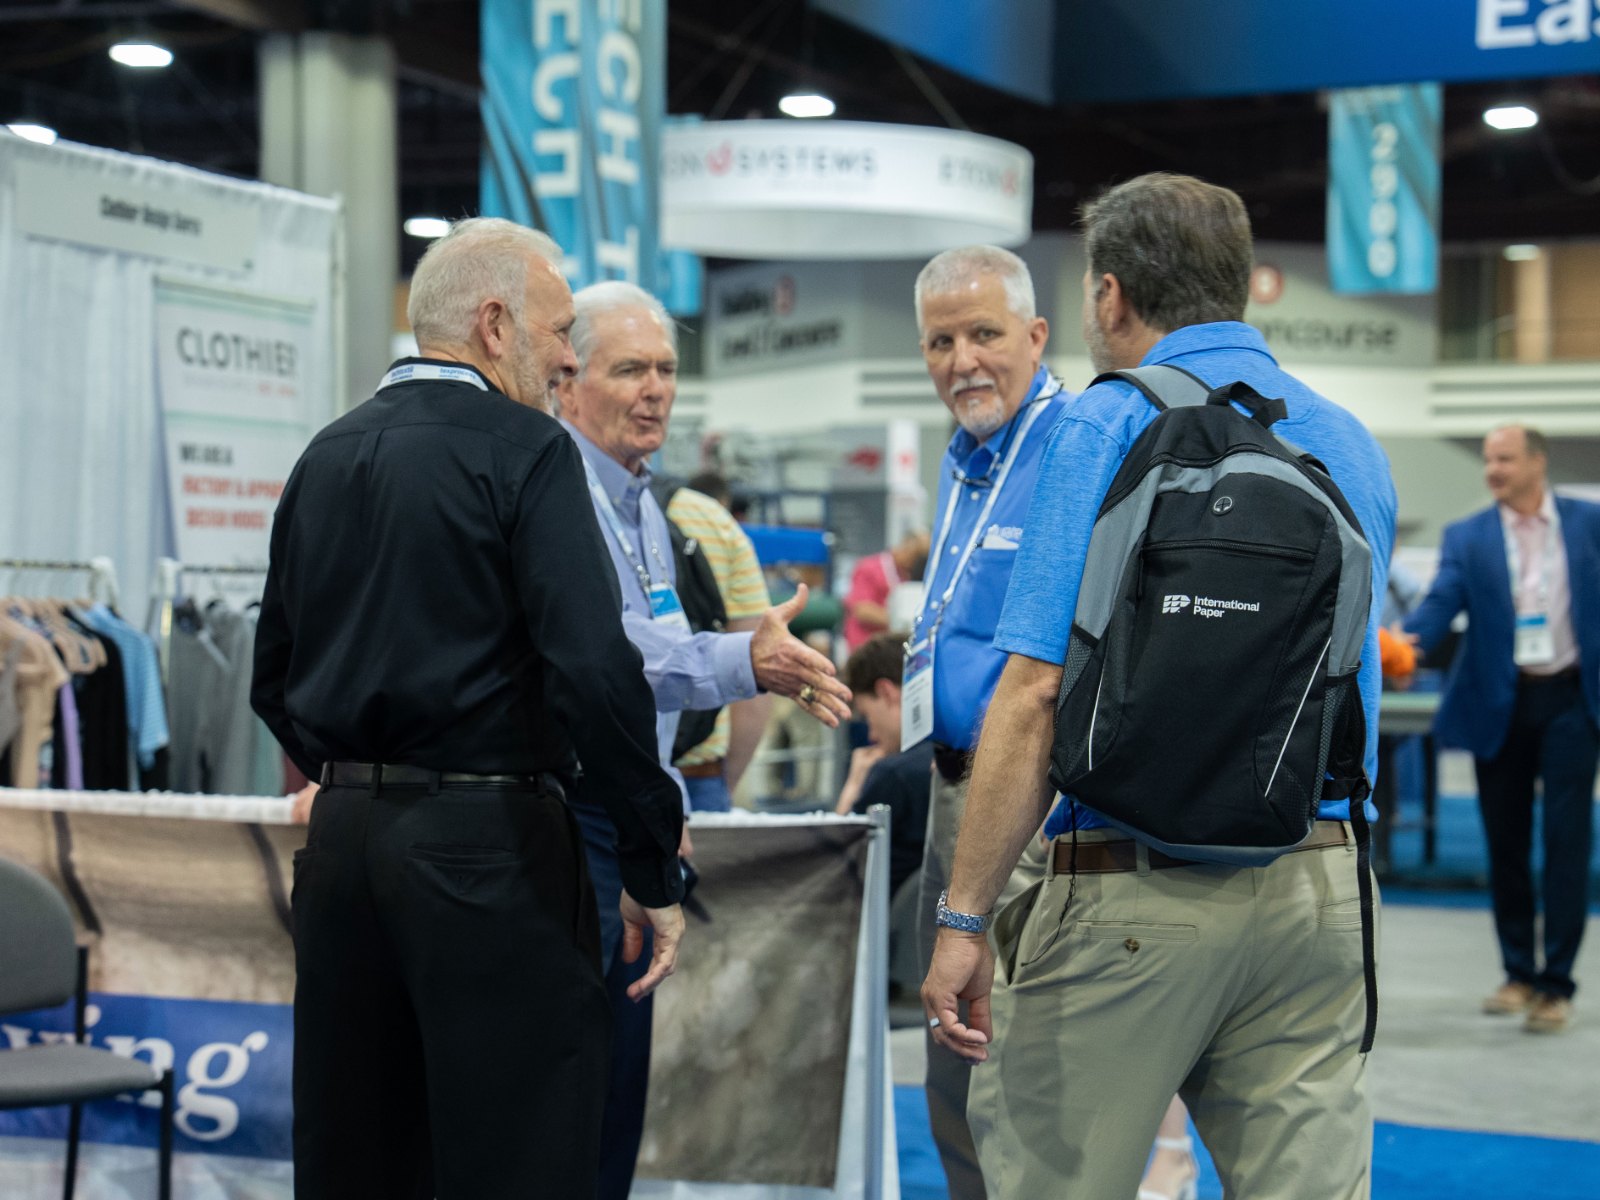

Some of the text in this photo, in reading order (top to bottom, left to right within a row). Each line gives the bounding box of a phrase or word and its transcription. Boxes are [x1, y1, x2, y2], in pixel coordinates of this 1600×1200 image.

[1475, 0, 1600, 50] Ea
[1193, 606, 1225, 618] Paper
[1194, 595, 1260, 612] International
